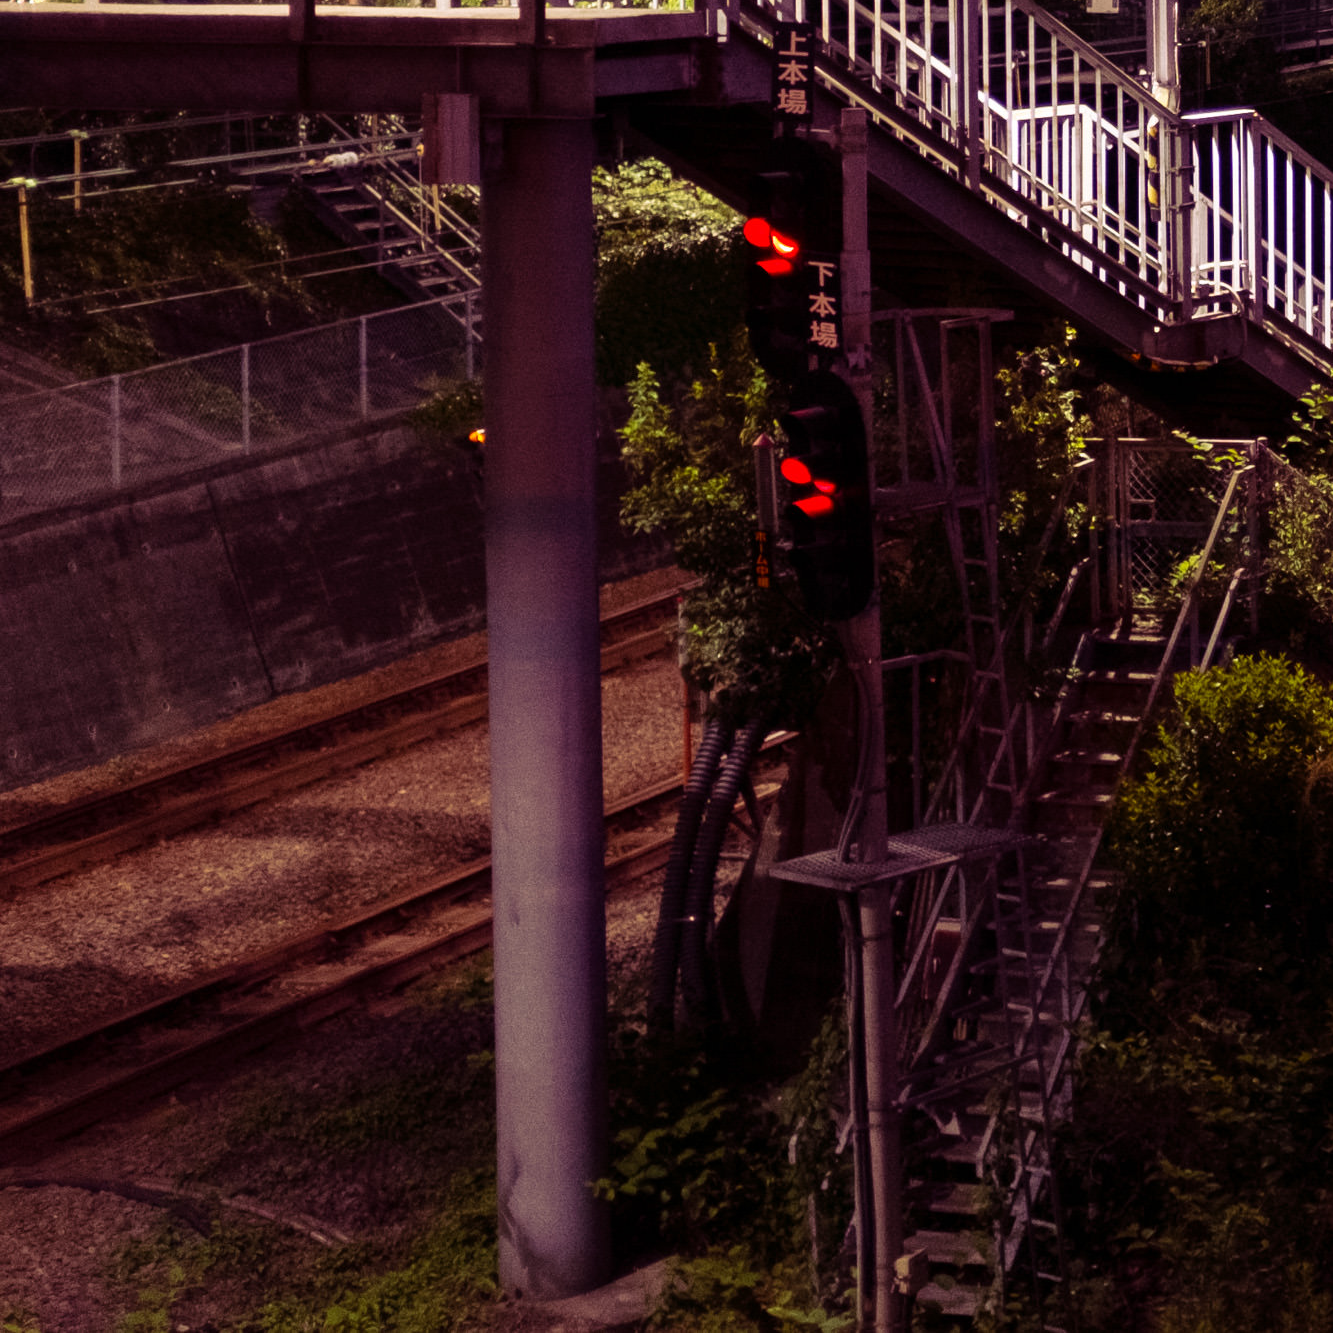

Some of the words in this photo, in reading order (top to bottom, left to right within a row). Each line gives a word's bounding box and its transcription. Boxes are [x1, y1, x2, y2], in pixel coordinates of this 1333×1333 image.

[778, 31, 809, 115] 上本場
[807, 261, 838, 349] 下本場
